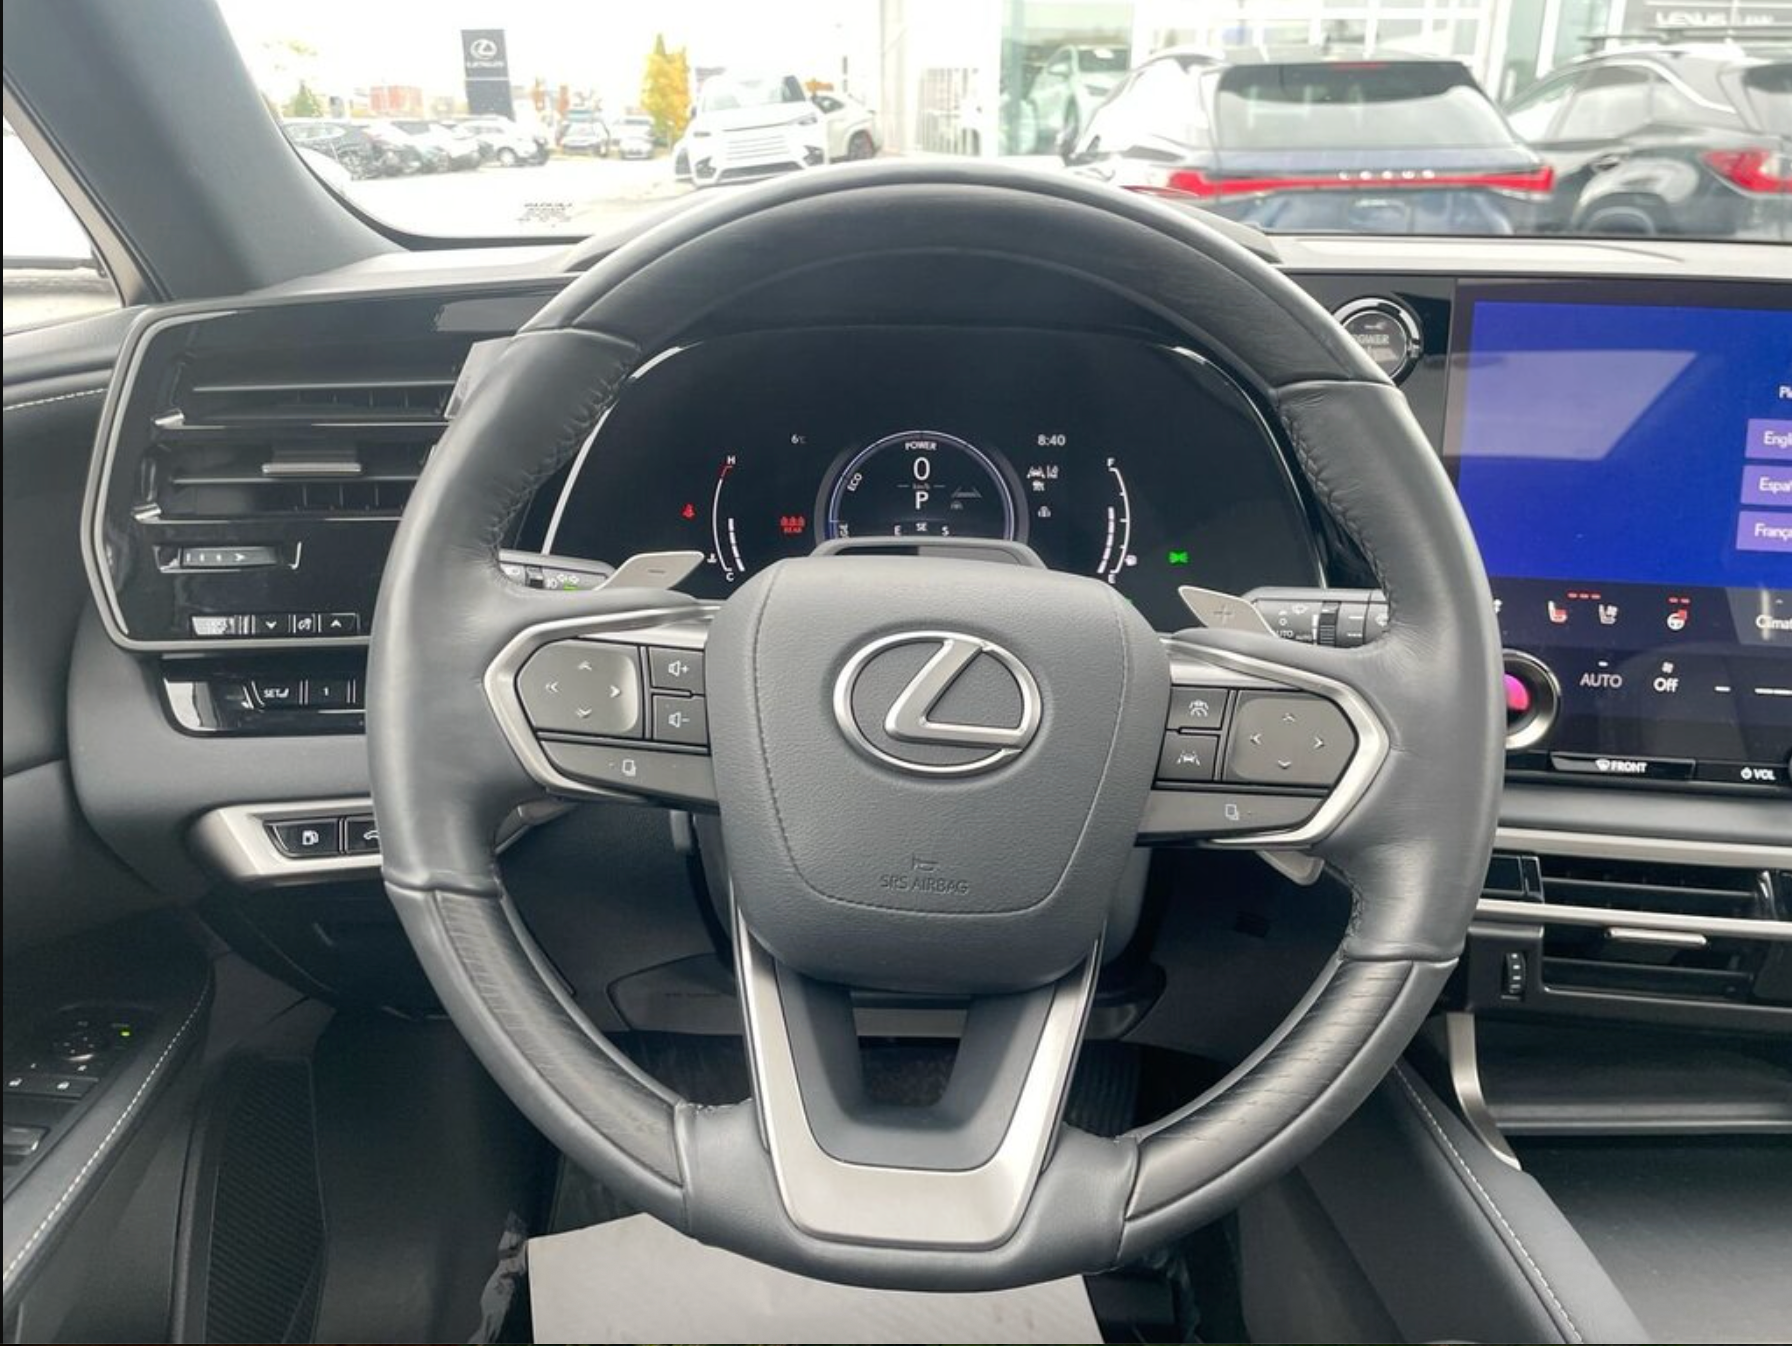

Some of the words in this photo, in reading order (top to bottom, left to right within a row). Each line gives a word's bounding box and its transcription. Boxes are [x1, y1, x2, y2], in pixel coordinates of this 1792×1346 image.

[1655, 11, 1727, 27] LEXUS
[905, 441, 936, 451] POWER
[1037, 434, 1066, 446] 8:40
[727, 455, 736, 465] H
[1107, 457, 1115, 467] F
[847, 472, 863, 492] ECO
[1760, 476, 1792, 494] Espa
[915, 491, 929, 510] P
[726, 571, 735, 582] C
[1276, 630, 1294, 638] UTO
[1580, 674, 1623, 688] AUTO
[1654, 678, 1679, 693] Off
[264, 688, 280, 698] SET
[1611, 760, 1648, 773] FRONT
[1753, 768, 1776, 780] VOL
[880, 874, 908, 891] SRS
[911, 878, 969, 896] AIRBAG
